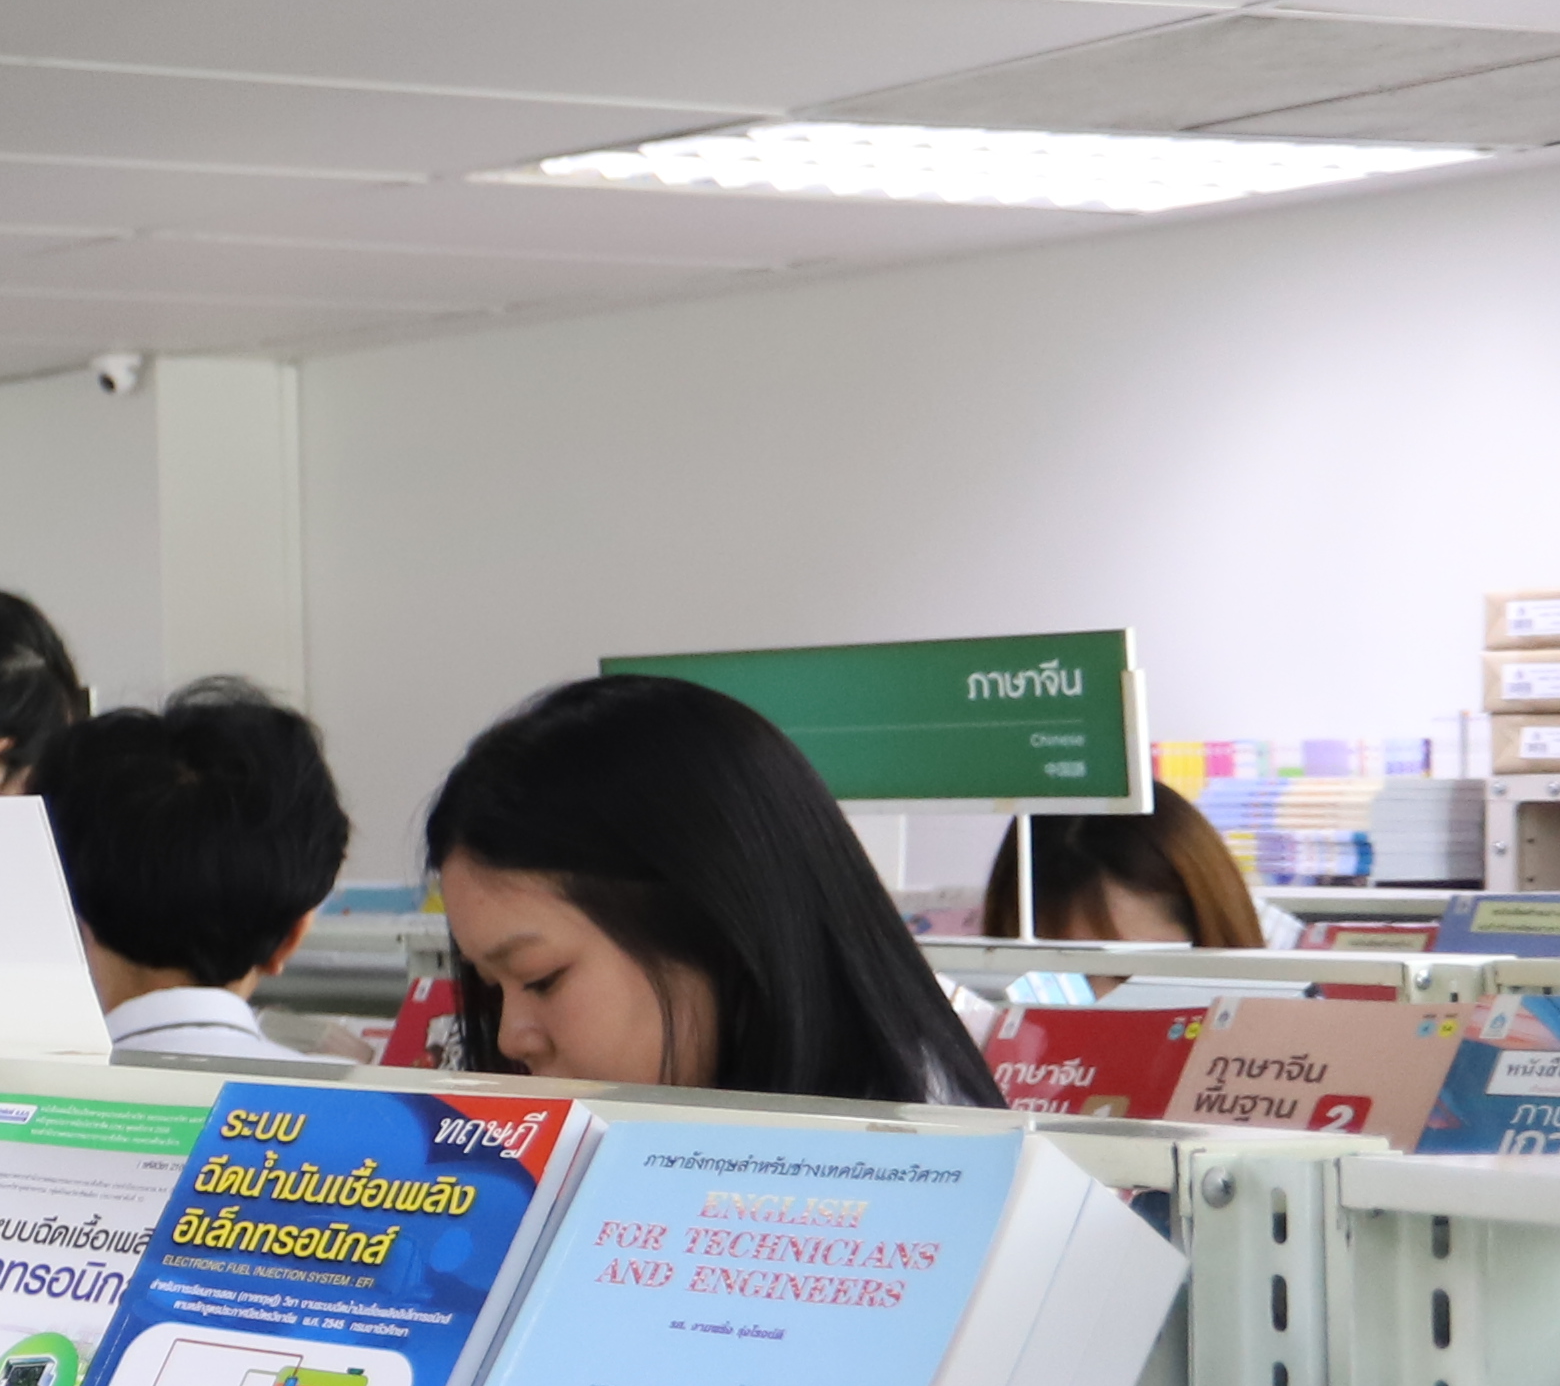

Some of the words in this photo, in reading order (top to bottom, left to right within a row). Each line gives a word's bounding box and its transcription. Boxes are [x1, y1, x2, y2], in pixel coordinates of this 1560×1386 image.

[966, 660, 1083, 702] ภาษาจีน
[1030, 731, 1085, 748] Chinese
[993, 1059, 1097, 1088] ภาษาจีน
[1206, 1052, 1329, 1084] ภาษาจีน
[1507, 1058, 1560, 1081] หนังสื
[221, 1108, 307, 1143] ระบบ
[1193, 1083, 1298, 1122] พื้นฐาน
[1323, 1103, 1357, 1133] 2
[434, 1111, 549, 1159] ทฤษฎี
[193, 1151, 477, 1216] ฉีดน้ำมันเชื้อเพลิง
[643, 1150, 963, 1185] ภาษาอังกฤษสำหรับช่างเทคนิคและวิศวกร
[699, 1192, 868, 1229] ENGLISH
[172, 1206, 401, 1266] อิเล็กทรอนิกส์
[593, 1220, 668, 1252] FOR
[682, 1226, 942, 1271] TECHNICIANS
[162, 1255, 225, 1273] ELECTRONIC
[225, 1262, 252, 1277] FUEL
[253, 1266, 306, 1282] INJECTION
[306, 1270, 350, 1286] SYSTEM
[357, 1277, 375, 1289] EFI
[595, 1258, 674, 1288] AND
[686, 1265, 908, 1309] ENGINEERS
